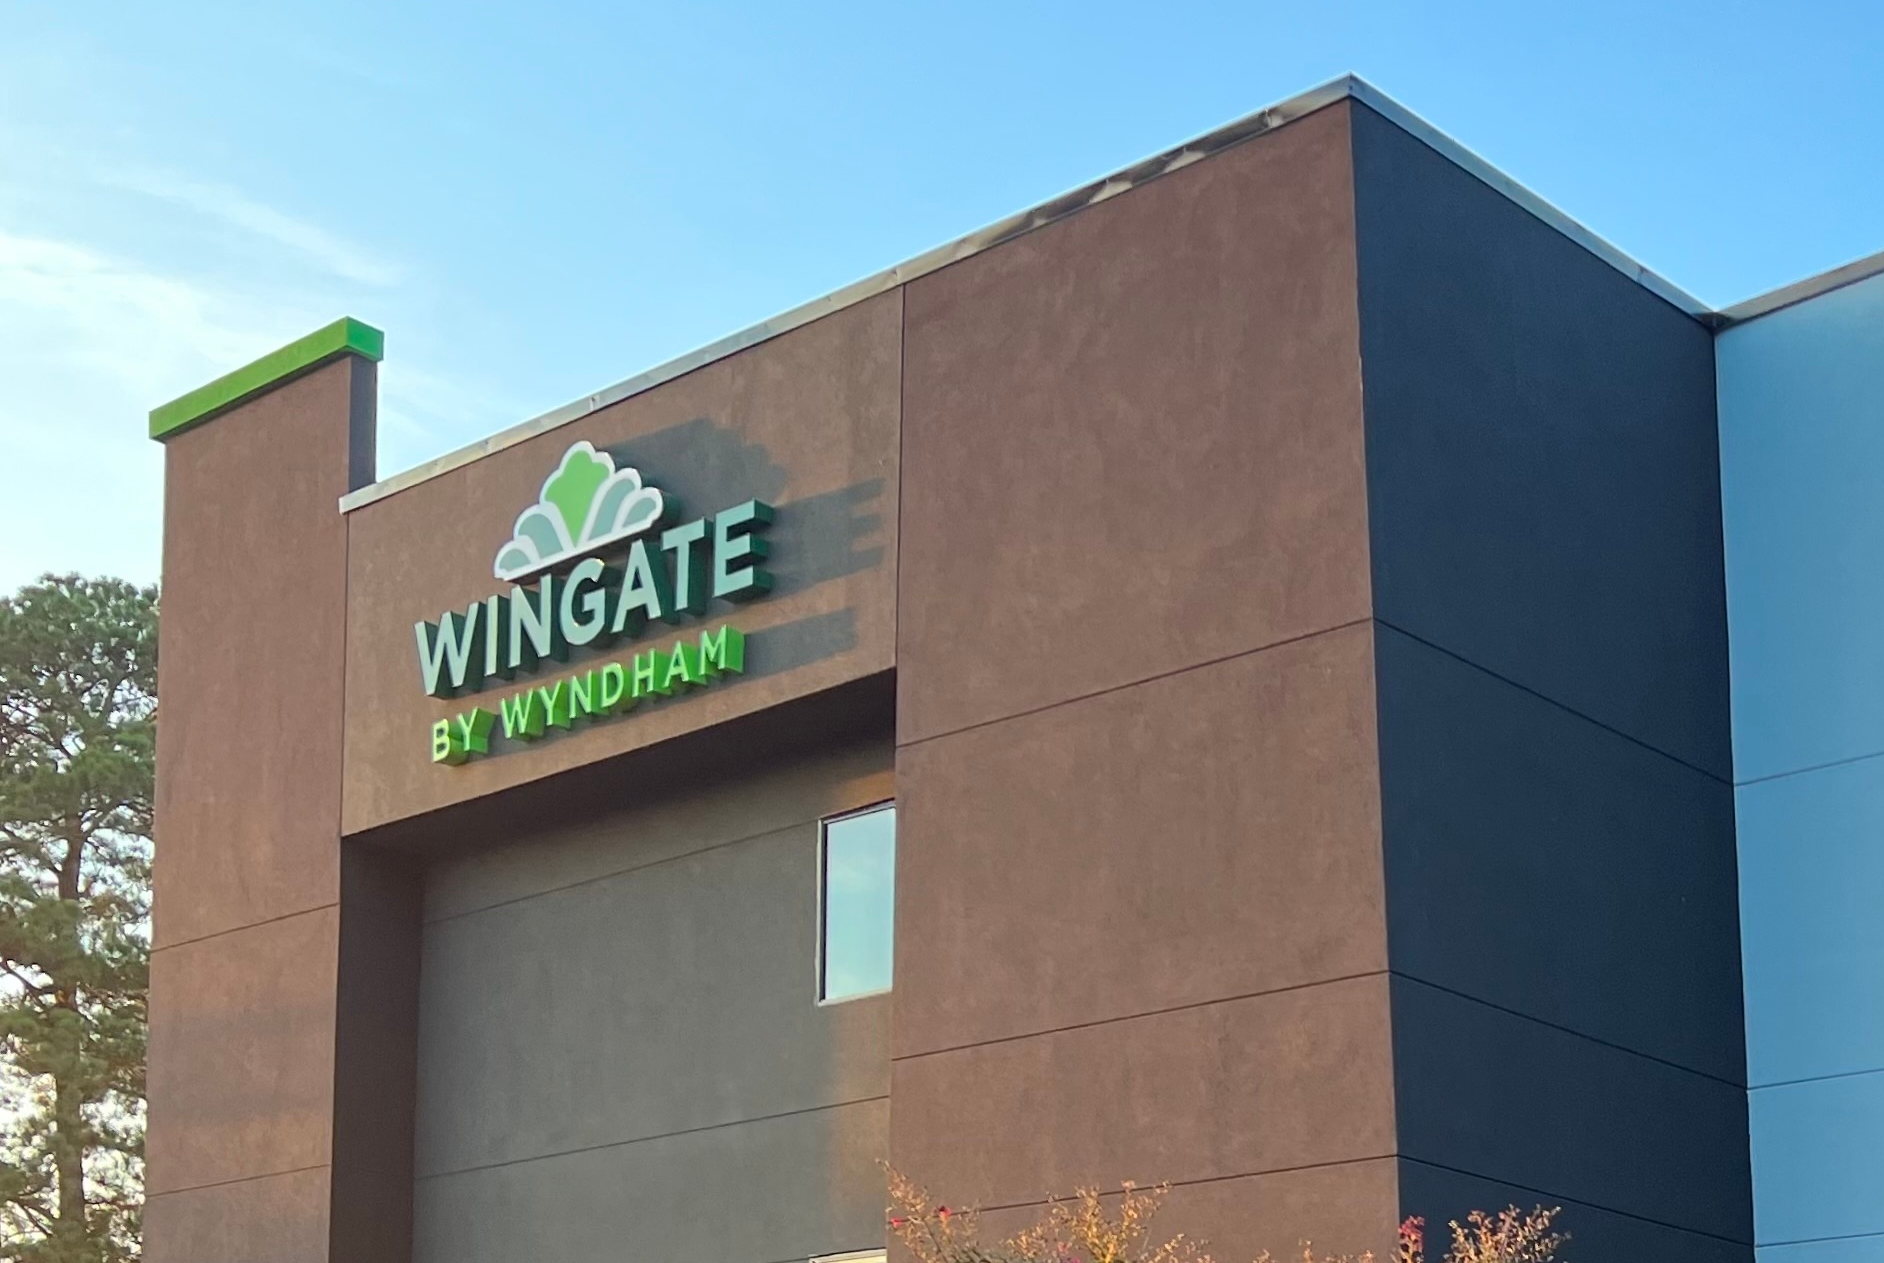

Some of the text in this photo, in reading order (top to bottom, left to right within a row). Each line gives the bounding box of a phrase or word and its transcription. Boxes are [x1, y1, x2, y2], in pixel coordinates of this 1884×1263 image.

[414, 498, 768, 697] WINGATE
[432, 625, 738, 763] BY WYNDHAM
